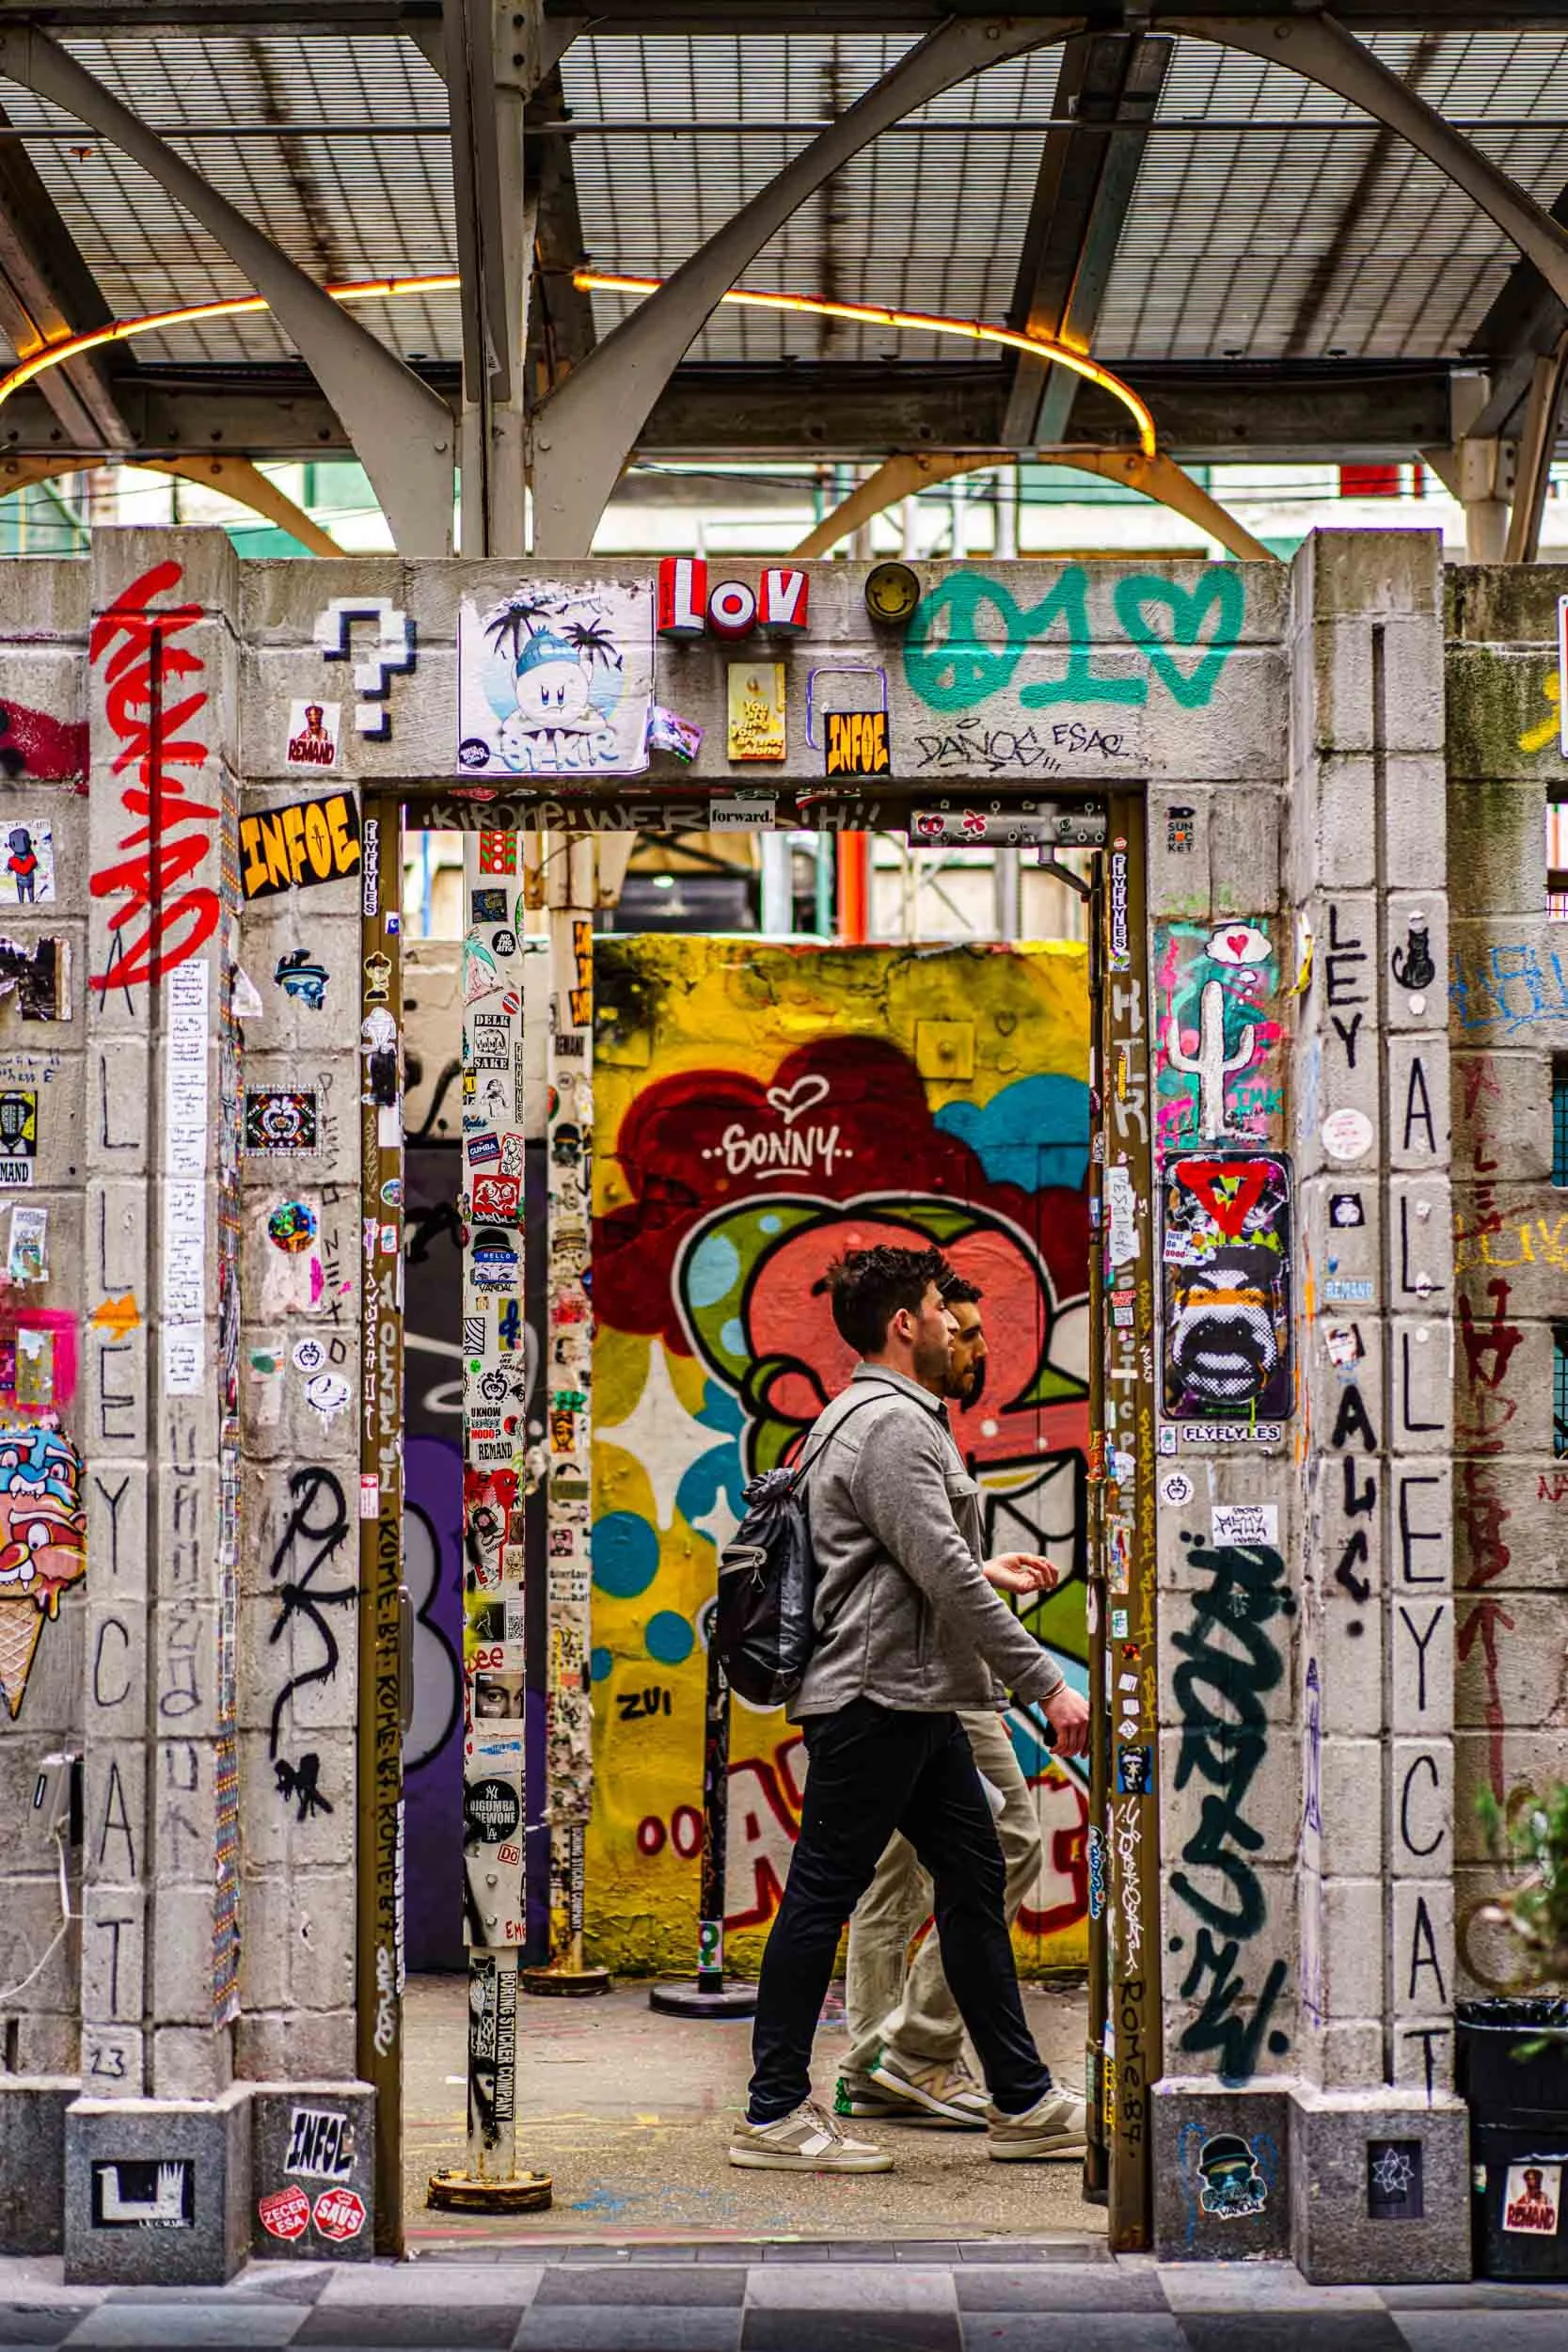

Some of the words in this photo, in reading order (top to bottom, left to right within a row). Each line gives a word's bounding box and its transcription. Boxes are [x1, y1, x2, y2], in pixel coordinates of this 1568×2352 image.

[286, 739, 335, 766] REMAND
[828, 713, 889, 775] INFOE
[712, 808, 773, 823] forward.
[1167, 821, 1194, 831] SUN
[240, 796, 360, 898] INFOE
[1167, 842, 1193, 851] KET
[1112, 855, 1128, 949] FLYFLYLES
[473, 1057, 509, 1069] SAKE
[468, 1143, 498, 1156] GUMBA
[0, 1163, 29, 1183] MAND
[478, 1283, 513, 1293] VANDAL
[1186, 1426, 1278, 1438] FLYFLYLES
[478, 1442, 513, 1460] REMAND
[499, 1972, 516, 2014] BORING
[497, 2016, 515, 2065] STICKER
[495, 2066, 515, 2120] COMPANY
[262, 2198, 308, 2225] ZECER
[276, 2214, 306, 2233] ESA
